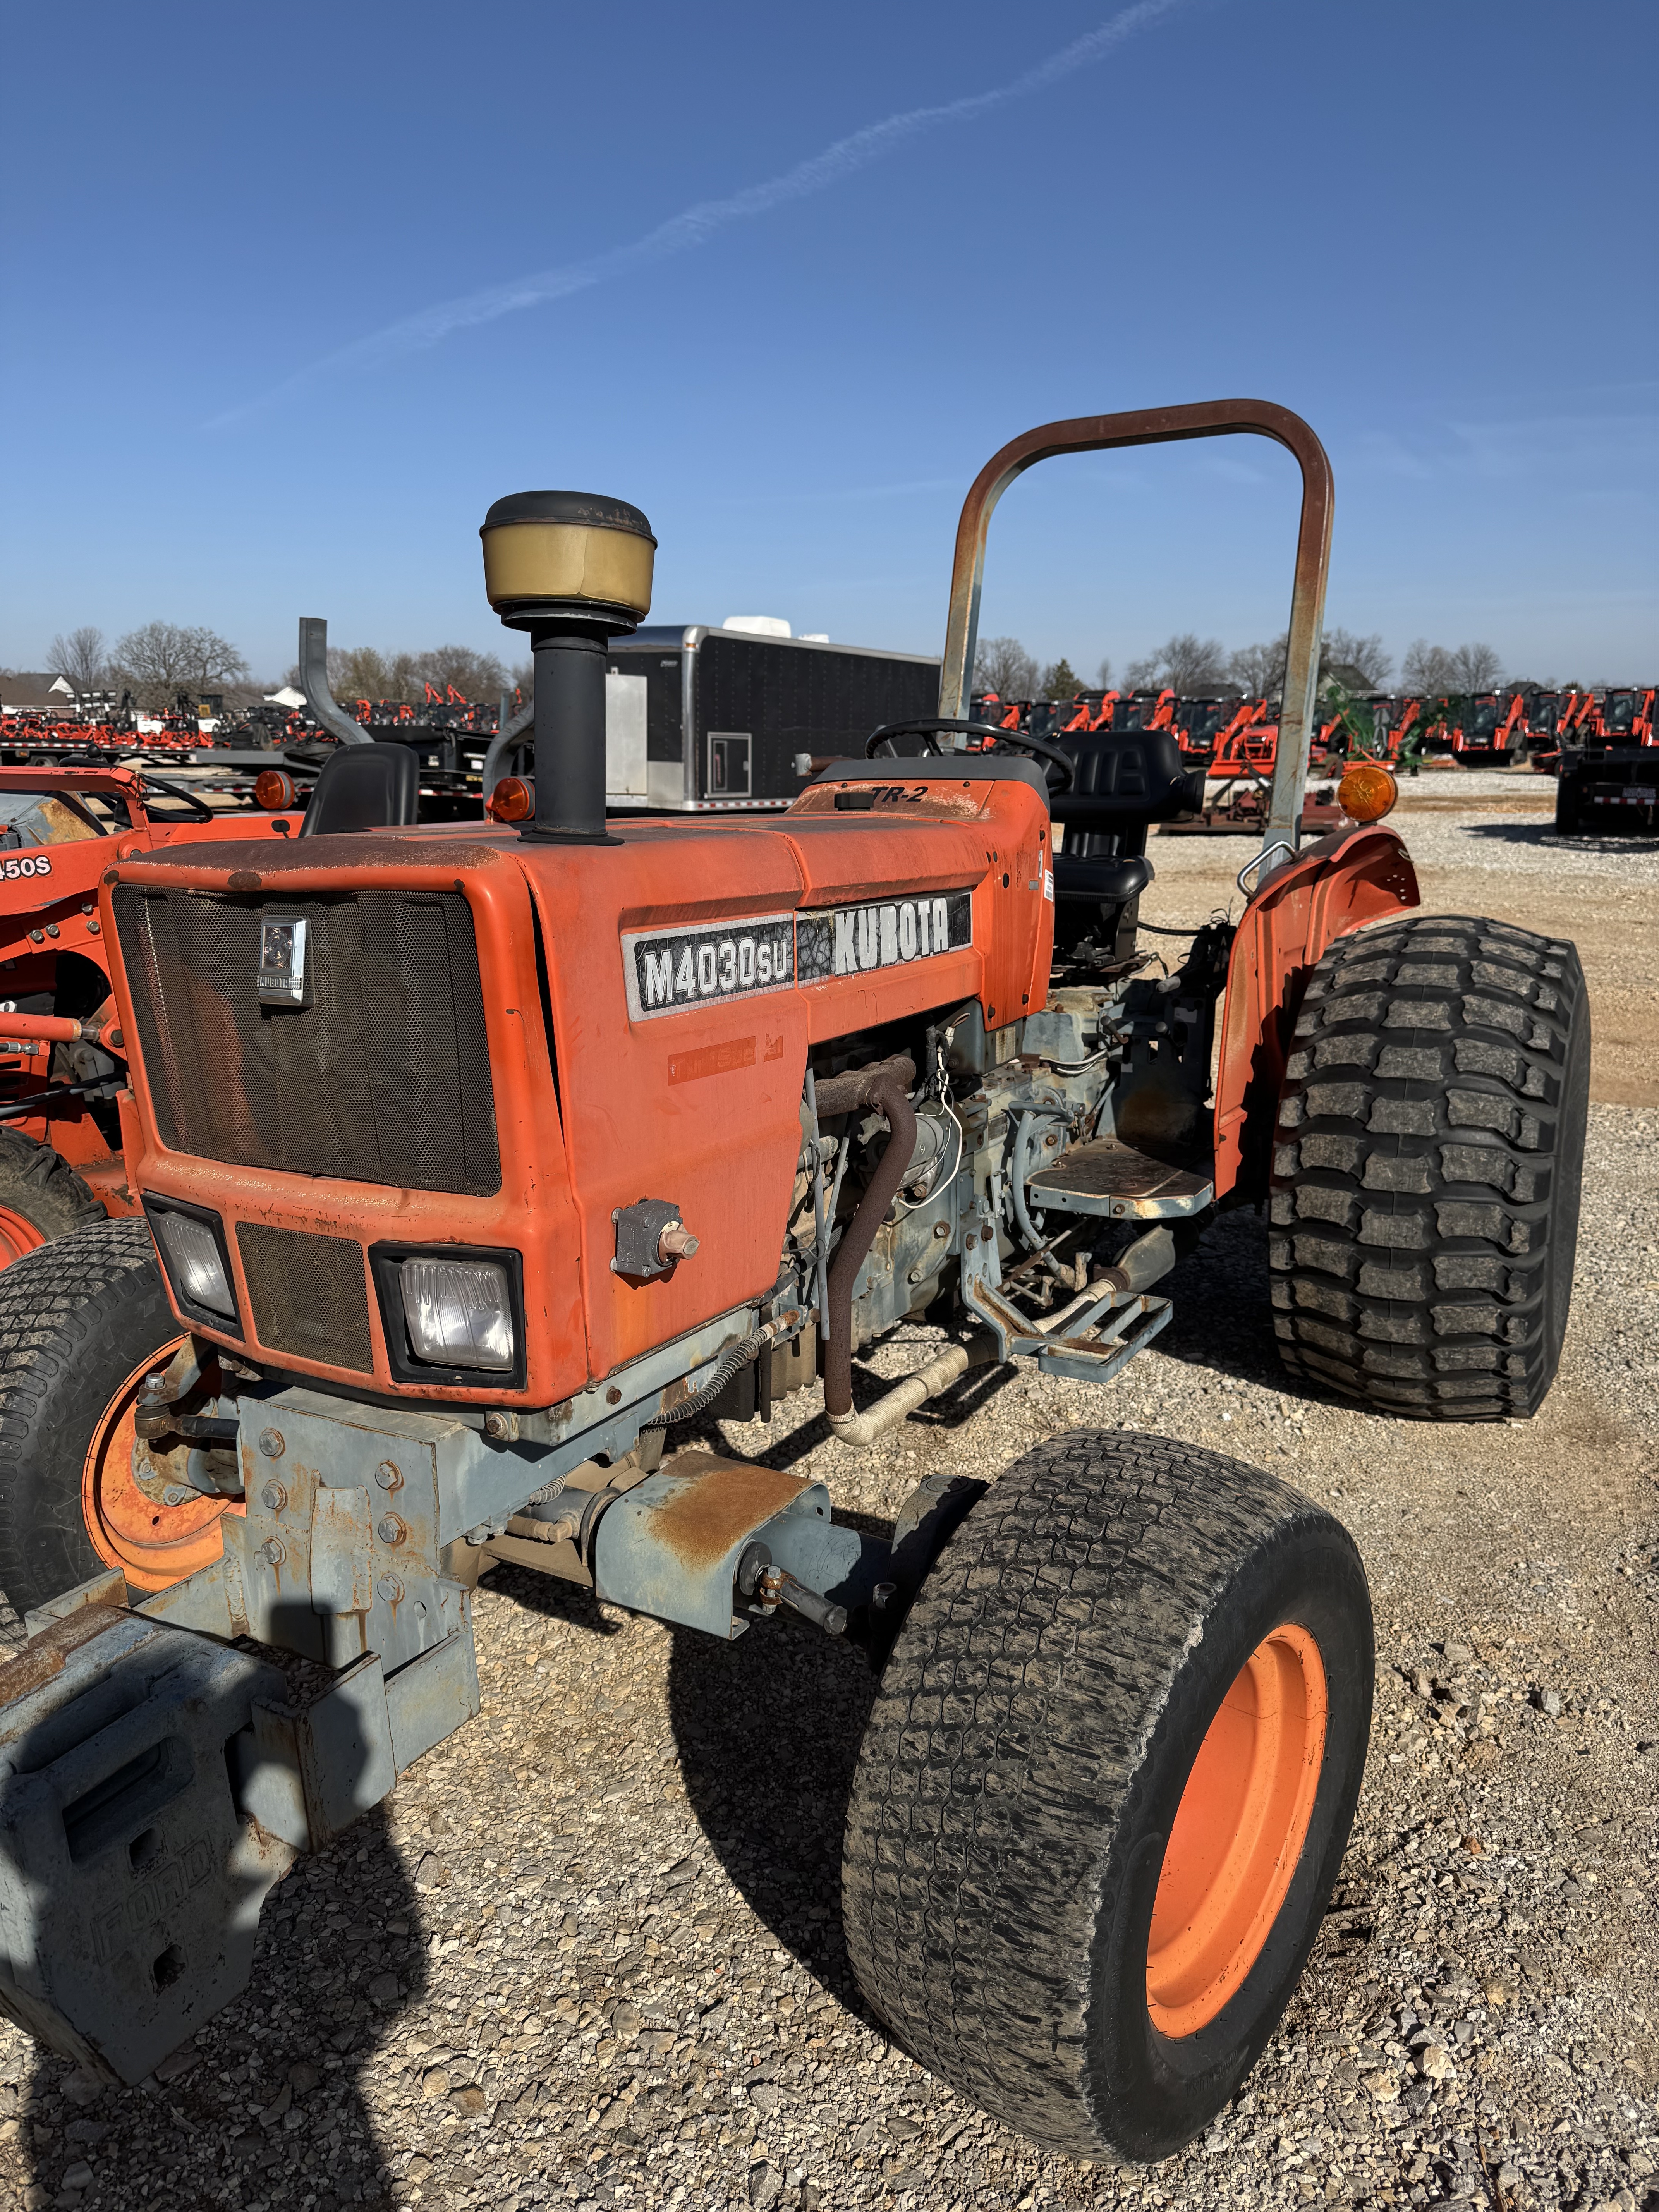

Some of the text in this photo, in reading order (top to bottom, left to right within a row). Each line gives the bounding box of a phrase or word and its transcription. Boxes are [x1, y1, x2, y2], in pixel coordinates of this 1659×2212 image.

[871, 786, 929, 802] TR-2
[644, 936, 787, 1007] M4030SU
[834, 896, 950, 977] KUBOTA
[260, 977, 288, 988] KUBOTA
[90, 1830, 215, 1967] FORD
